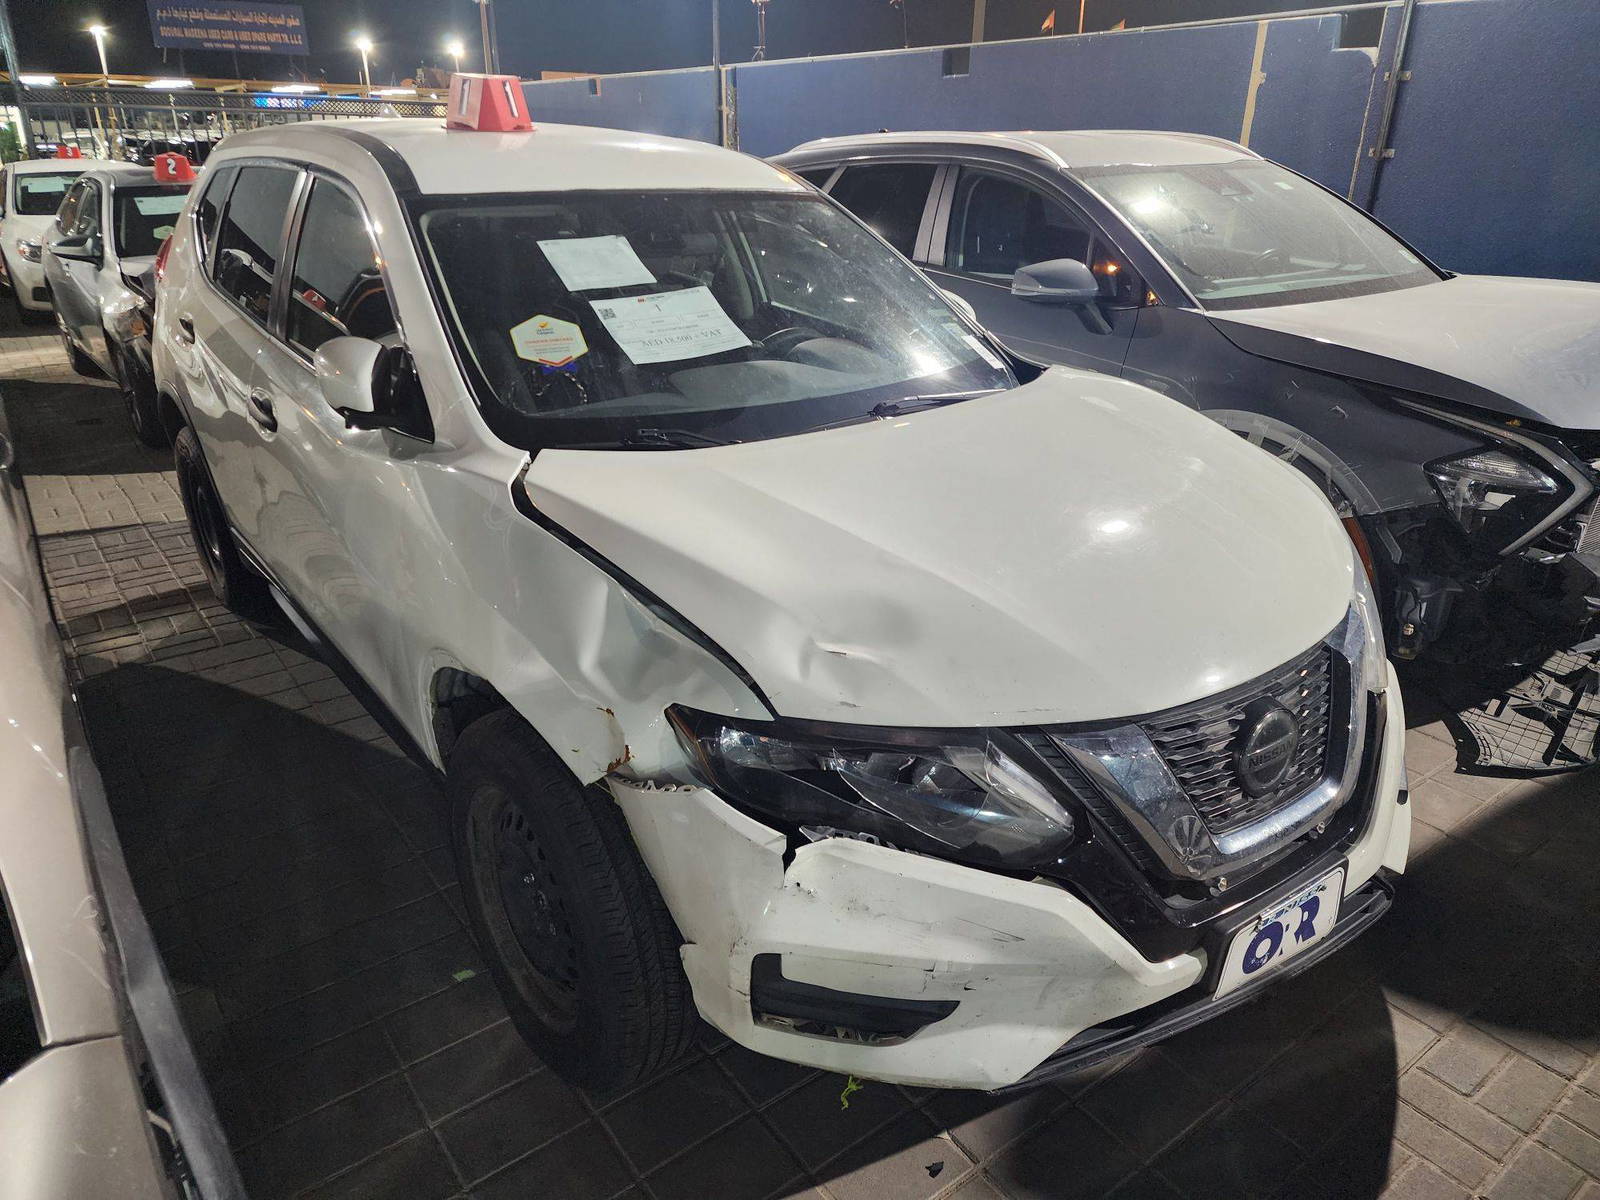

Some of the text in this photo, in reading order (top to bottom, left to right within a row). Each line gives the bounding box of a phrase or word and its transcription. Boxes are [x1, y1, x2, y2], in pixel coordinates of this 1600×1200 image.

[460, 79, 471, 117] 1
[502, 79, 519, 118] 1
[67, 147, 73, 157] 3
[166, 158, 177, 175] 2
[701, 328, 722, 338] VAT
[1248, 744, 1293, 770] NISSAN
